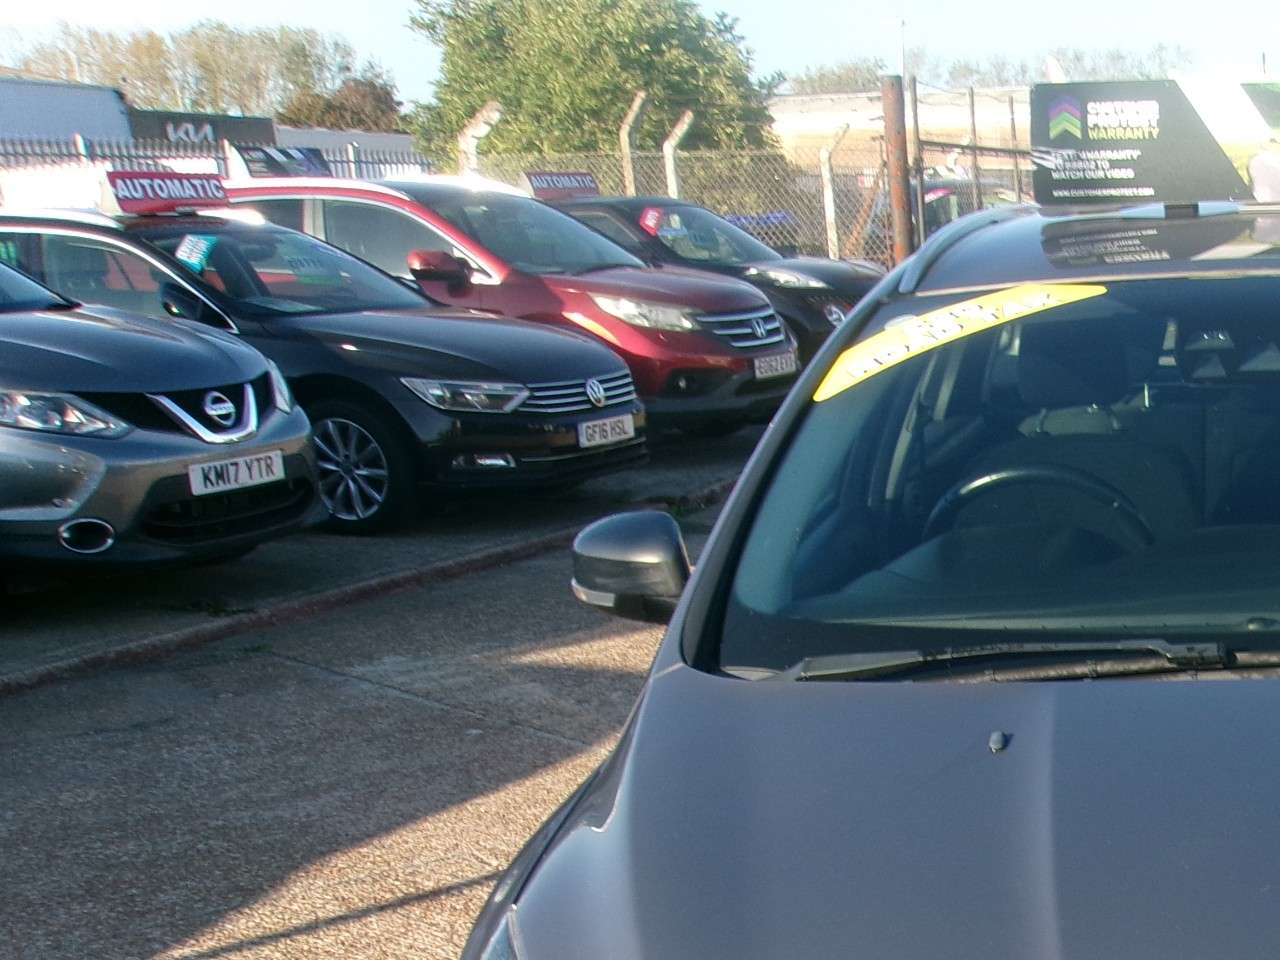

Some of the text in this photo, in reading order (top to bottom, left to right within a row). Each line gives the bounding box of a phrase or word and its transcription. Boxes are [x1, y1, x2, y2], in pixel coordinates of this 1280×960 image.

[1087, 127, 1160, 140] WARRANTY
[115, 178, 225, 200] AUTOMATIC
[531, 174, 597, 189] AUTOMATIC
[201, 455, 276, 489] KM17 YTR
